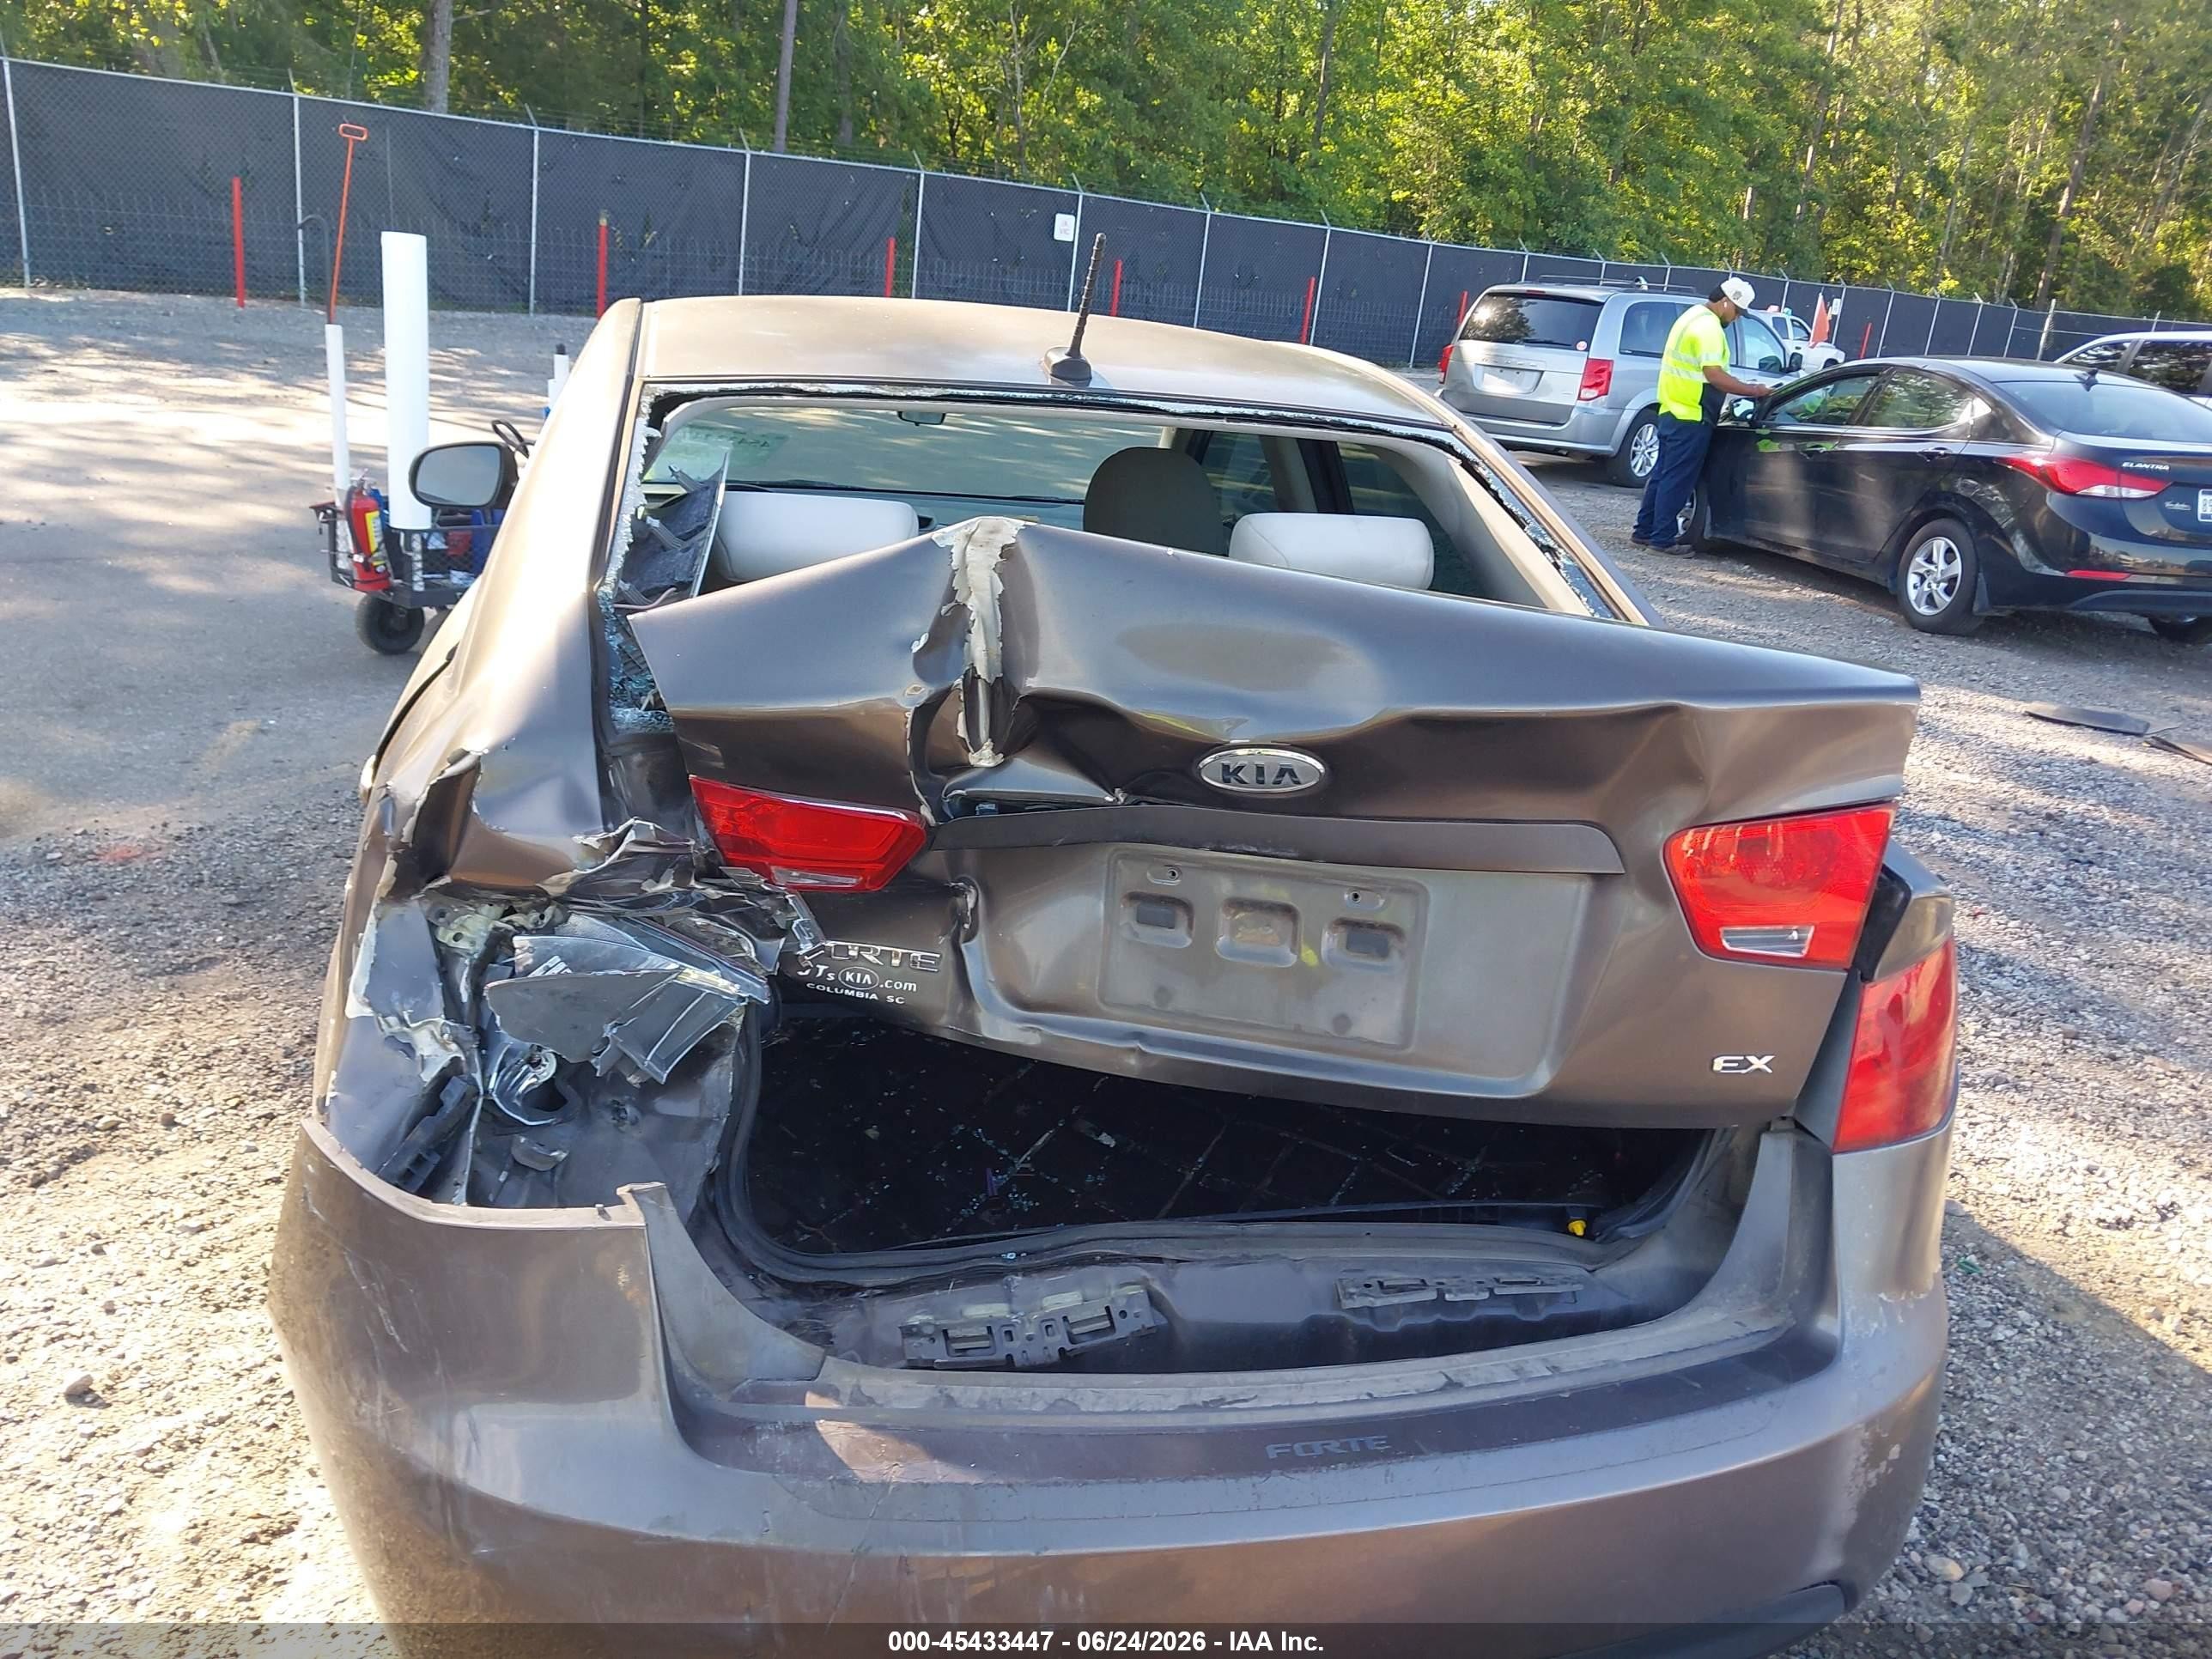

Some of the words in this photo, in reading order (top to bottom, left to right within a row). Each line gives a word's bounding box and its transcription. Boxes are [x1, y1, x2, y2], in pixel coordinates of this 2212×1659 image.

[2122, 461, 2169, 471] ELANTRA
[1221, 761, 1302, 785] KIA
[806, 982, 878, 1000] COLUMBIA
[885, 994, 906, 1005] SC
[1713, 1055, 1776, 1073] EX
[1266, 1436, 1391, 1459] FORTE
